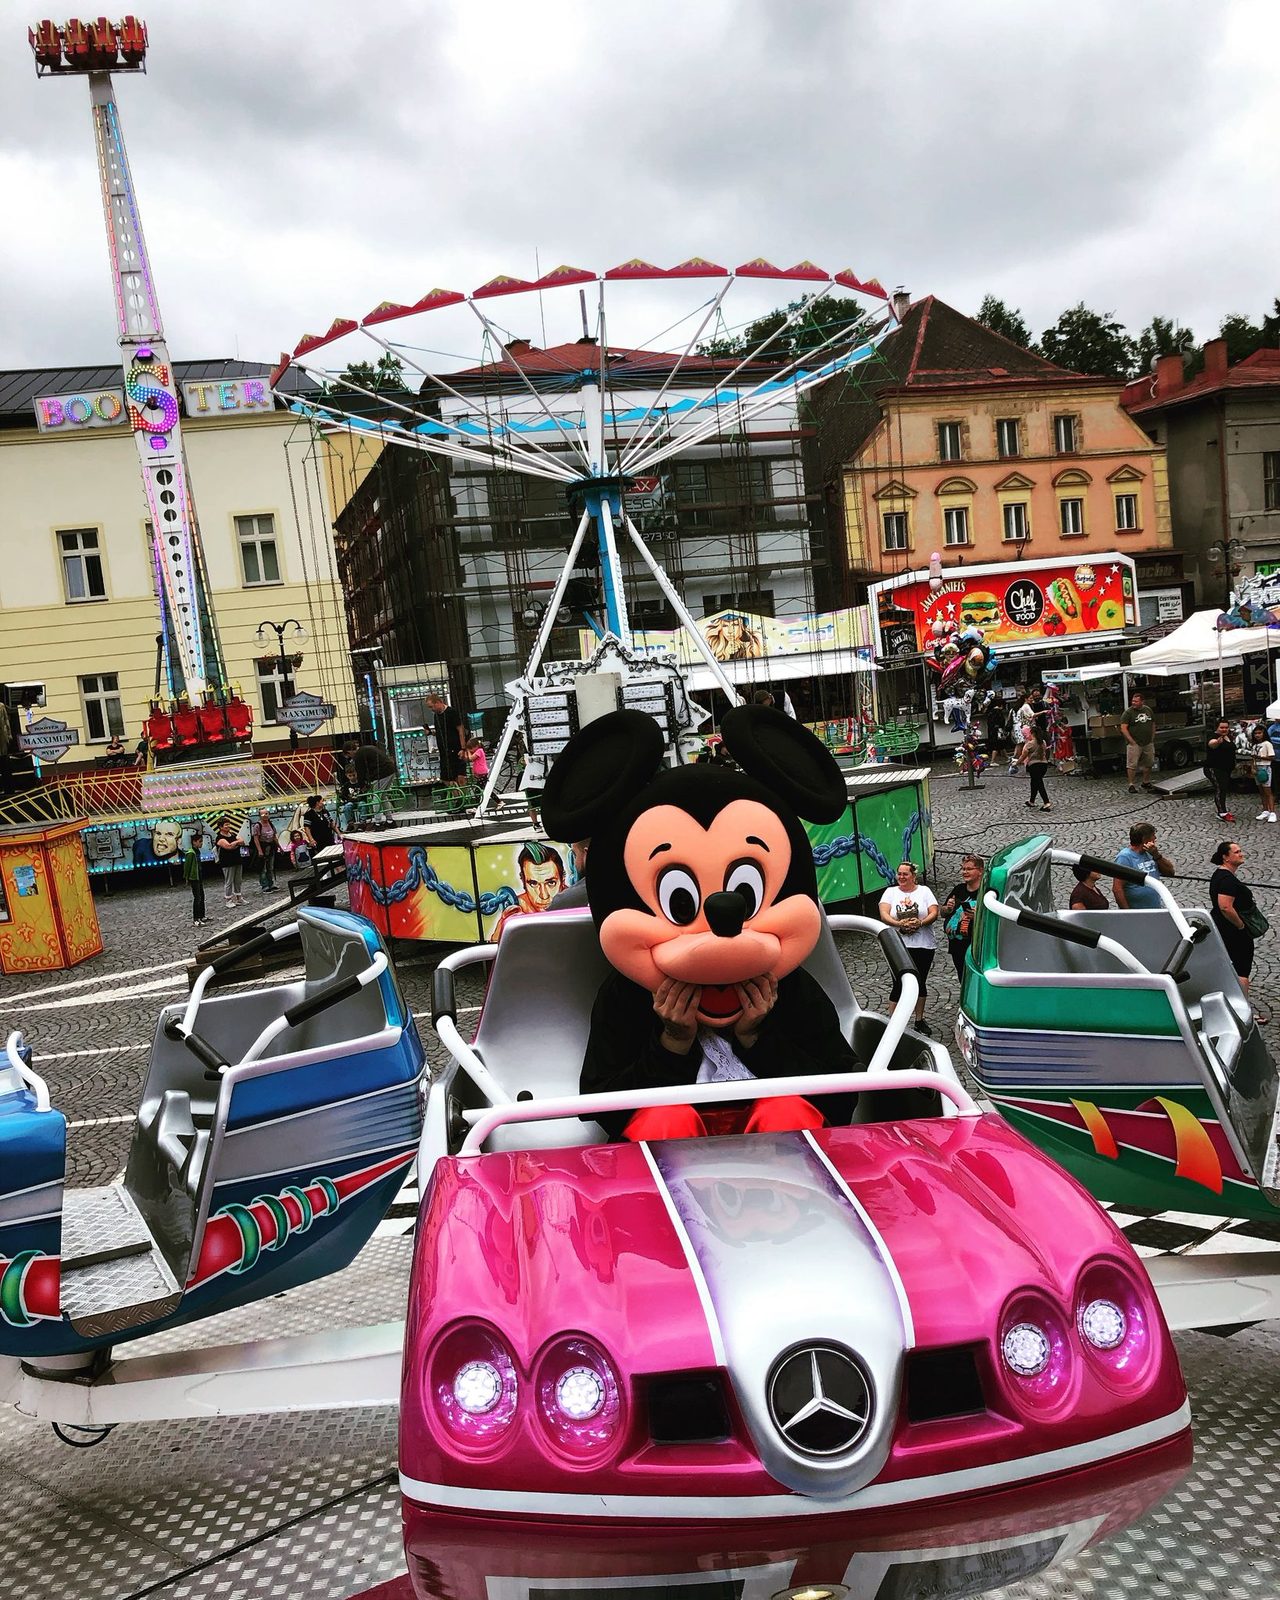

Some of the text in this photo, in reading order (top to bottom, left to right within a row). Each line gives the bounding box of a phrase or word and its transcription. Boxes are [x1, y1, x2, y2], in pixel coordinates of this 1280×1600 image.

[1010, 588, 1037, 612] Chef
[1015, 612, 1036, 622] FOOD
[280, 708, 329, 719] MAXXIMUM
[23, 734, 73, 746] MAXXIMUM
